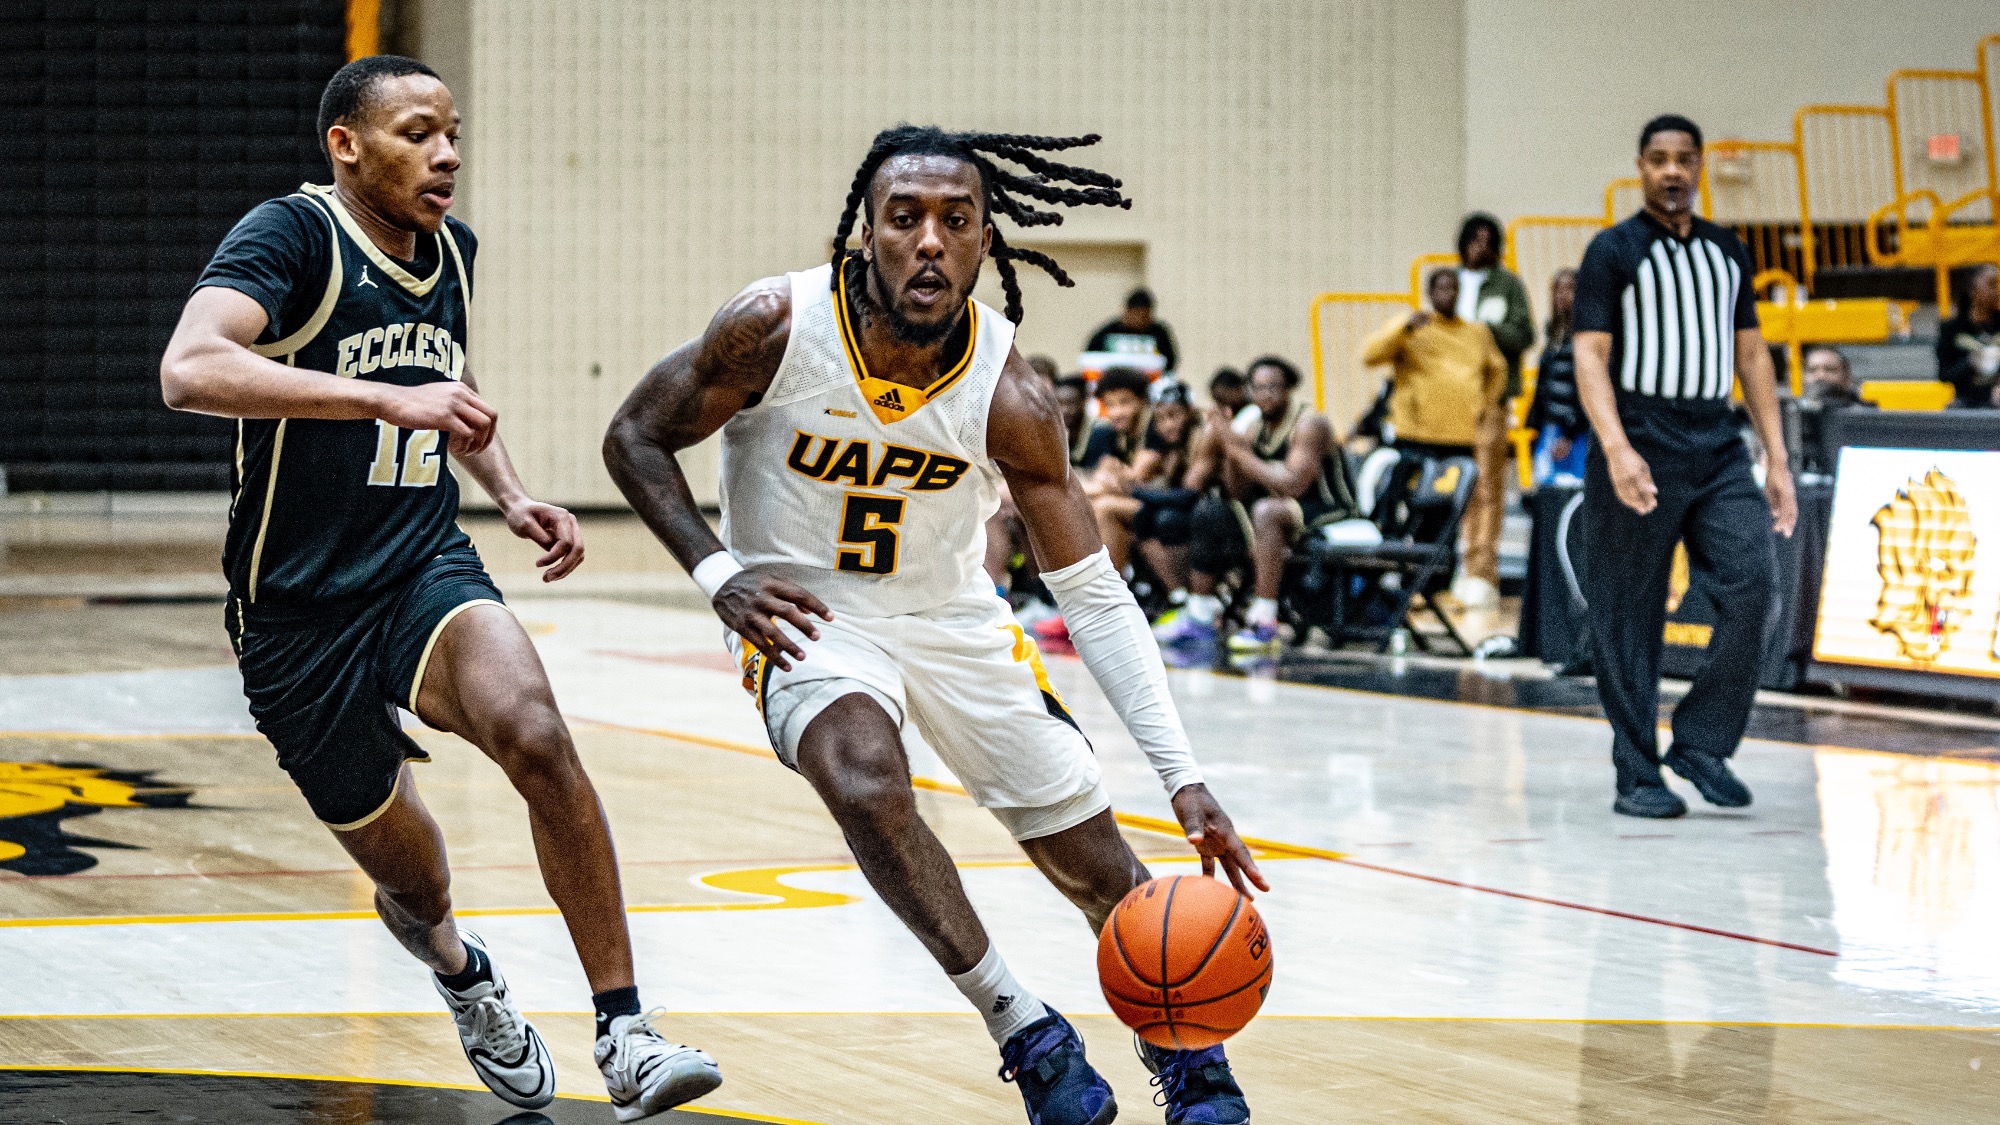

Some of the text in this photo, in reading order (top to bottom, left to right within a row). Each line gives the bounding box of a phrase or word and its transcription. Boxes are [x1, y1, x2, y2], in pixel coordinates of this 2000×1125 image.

[873, 399, 905, 413] adidas
[367, 418, 441, 487] 12
[786, 429, 972, 492] UAPB
[834, 491, 908, 576] 5
